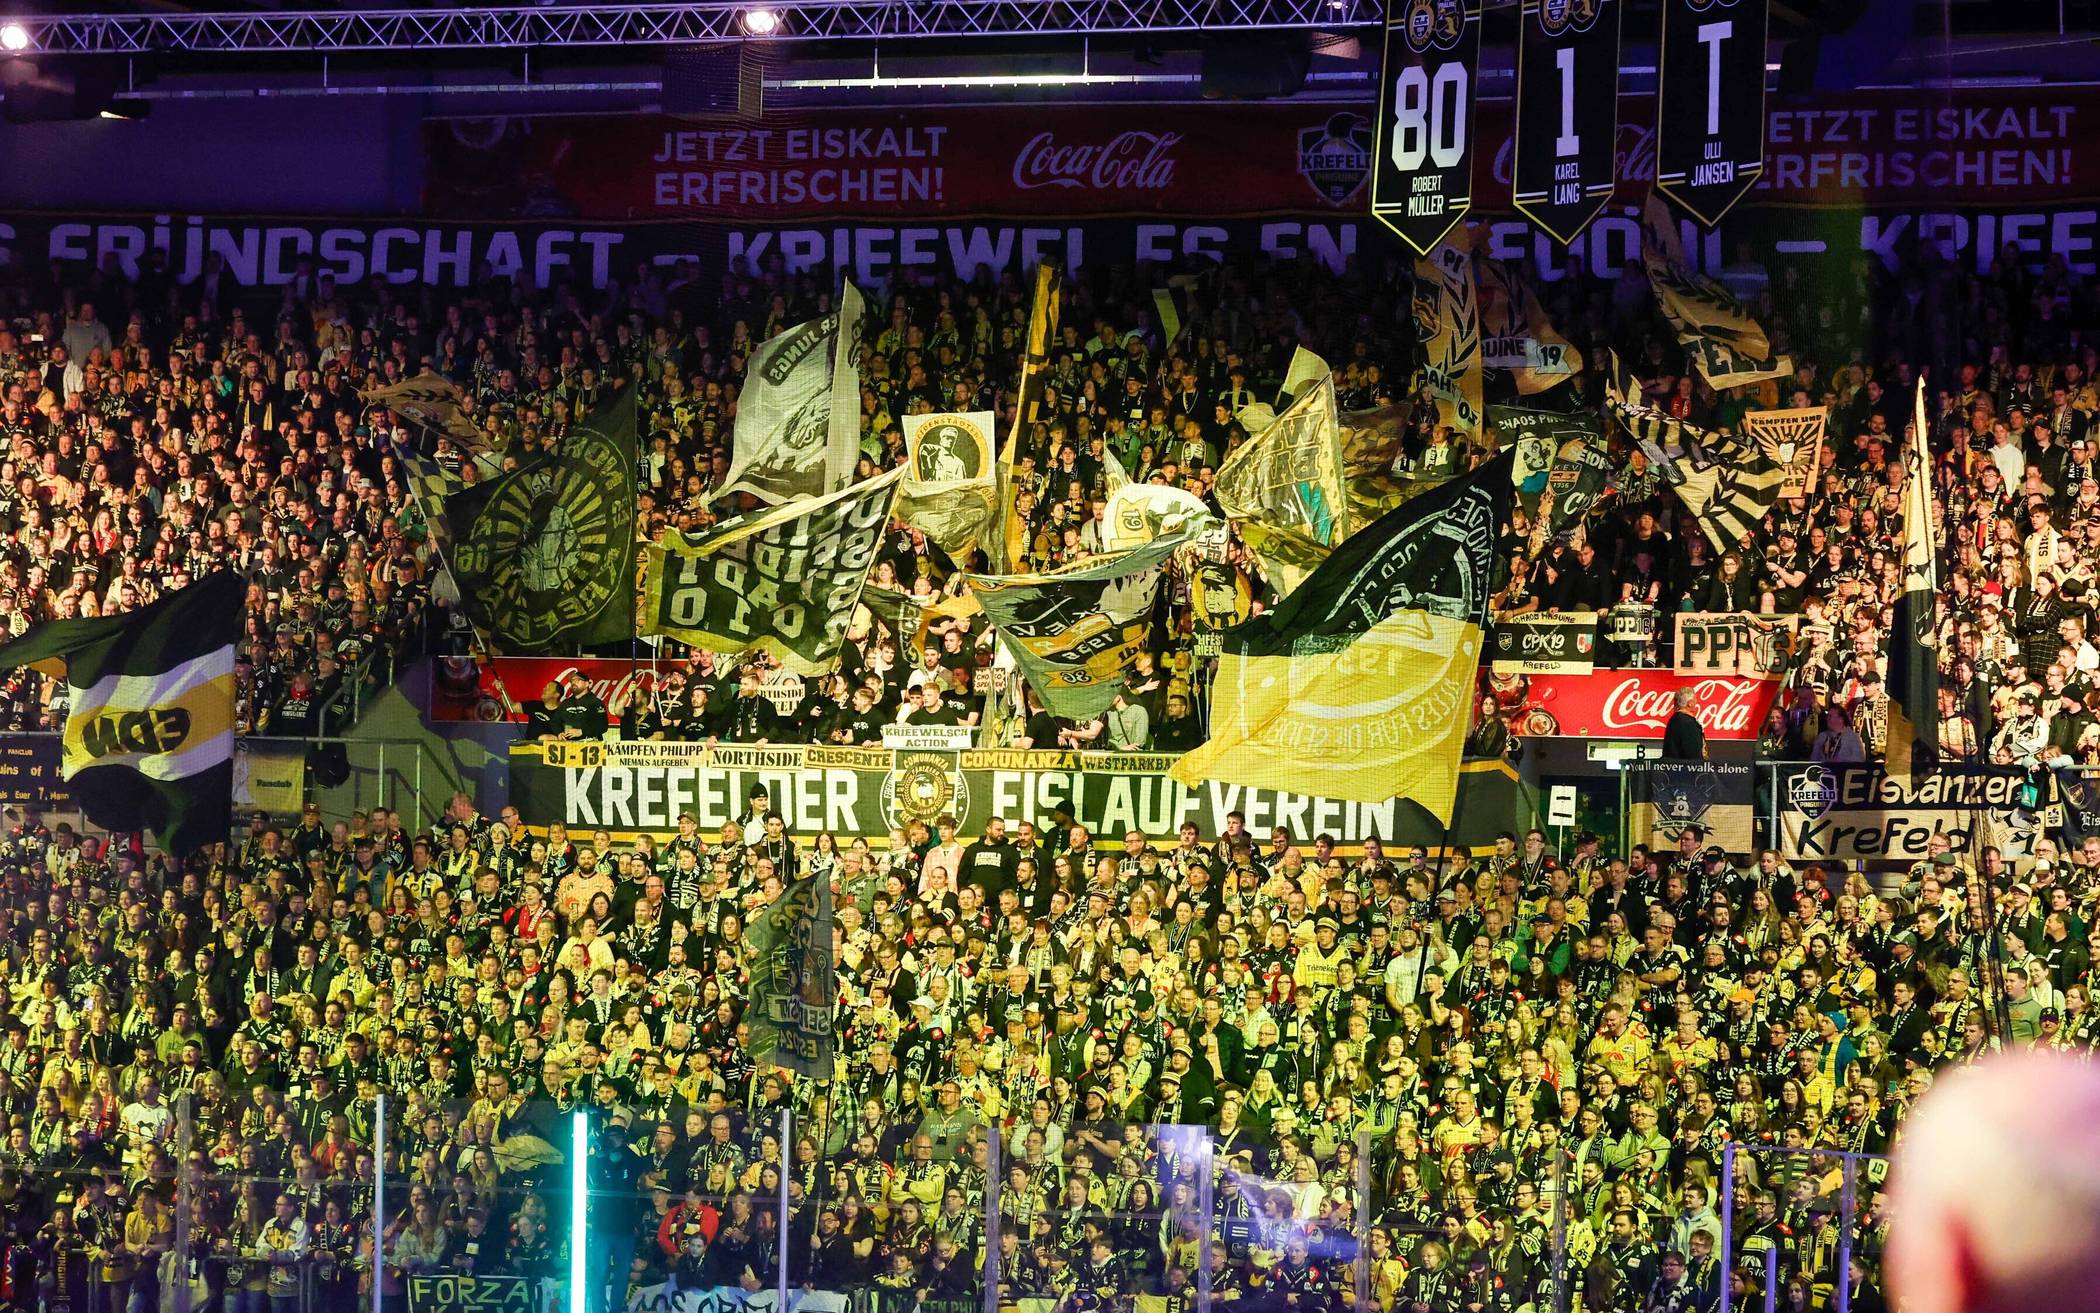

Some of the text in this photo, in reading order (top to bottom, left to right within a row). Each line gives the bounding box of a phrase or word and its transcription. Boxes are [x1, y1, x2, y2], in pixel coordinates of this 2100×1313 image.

[1556, 47, 1580, 157] 1
[1391, 61, 1468, 171] 80
[1767, 105, 2078, 143] ETZT EISKALT
[654, 126, 948, 162] JETZT EISKALT
[1704, 141, 1723, 160] ULLI
[1012, 130, 1185, 190] Coca-Cola
[1555, 161, 1581, 181] KAREL
[1691, 161, 1735, 187] JANSEN
[655, 167, 944, 205] ERFRISCHEN!
[1411, 174, 1443, 194] ROBERT
[1554, 182, 1581, 206] LANG
[1408, 194, 1444, 217] MÜLLER
[885, 727, 968, 737] KRIEEWELSCH
[606, 741, 704, 757] KÄMPFEN PHILIPP
[905, 738, 949, 748] ACTION
[548, 745, 566, 765] SJ
[580, 746, 600, 766] 13
[619, 757, 690, 768] NIEMALS AUFGEBEN
[712, 751, 803, 767] NORTHSIDE
[806, 749, 891, 767] CRESCENTE
[961, 751, 1076, 769] COMUNANZA
[30, 766, 42, 777] of
[1653, 763, 1684, 772] never
[1687, 761, 1715, 774] walk
[1717, 762, 1750, 774] alone
[256, 779, 293, 789] Fanclub
[564, 767, 860, 832] KREFELDER
[1791, 791, 1836, 800] KREFELD
[413, 1277, 530, 1305] FORZA
